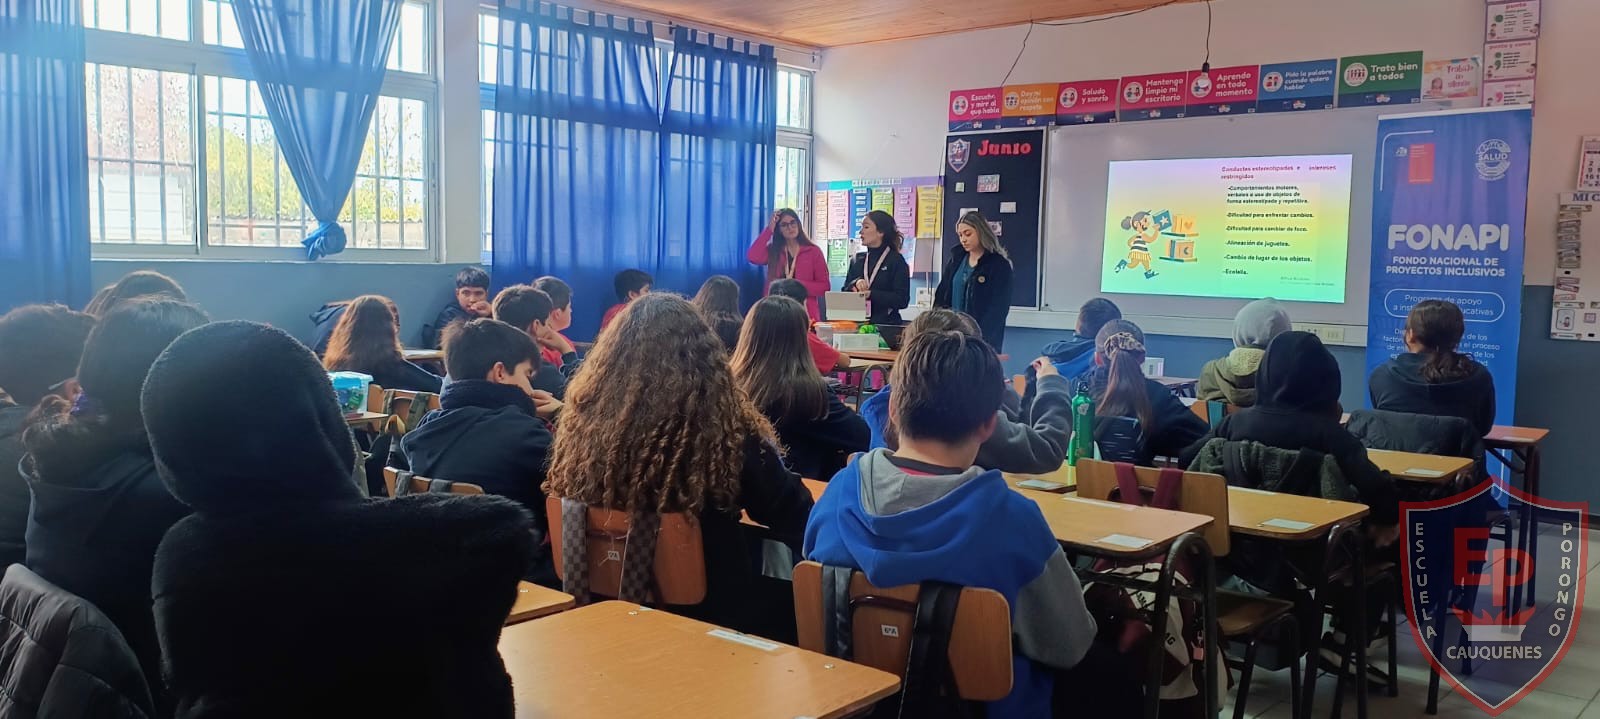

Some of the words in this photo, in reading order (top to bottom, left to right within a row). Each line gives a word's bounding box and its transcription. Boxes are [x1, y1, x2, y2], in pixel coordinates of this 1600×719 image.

[1371, 65, 1396, 73] Trato
[1217, 72, 1251, 82] Aprendo
[1378, 72, 1404, 80] todos
[1146, 79, 1183, 87] Mantengo
[1146, 87, 1167, 96] limpio
[977, 140, 1031, 155] Junio
[1573, 193, 1589, 201] MI
[1388, 224, 1509, 251] FONAPI
[1393, 256, 1428, 265] FONDO
[1430, 257, 1481, 266] NACIONAL
[1484, 258, 1498, 266] DE
[1386, 266, 1442, 275] PROYECTOS
[1445, 267, 1505, 277] INCLUSIVOS
[1457, 298, 1482, 306] apoyo
